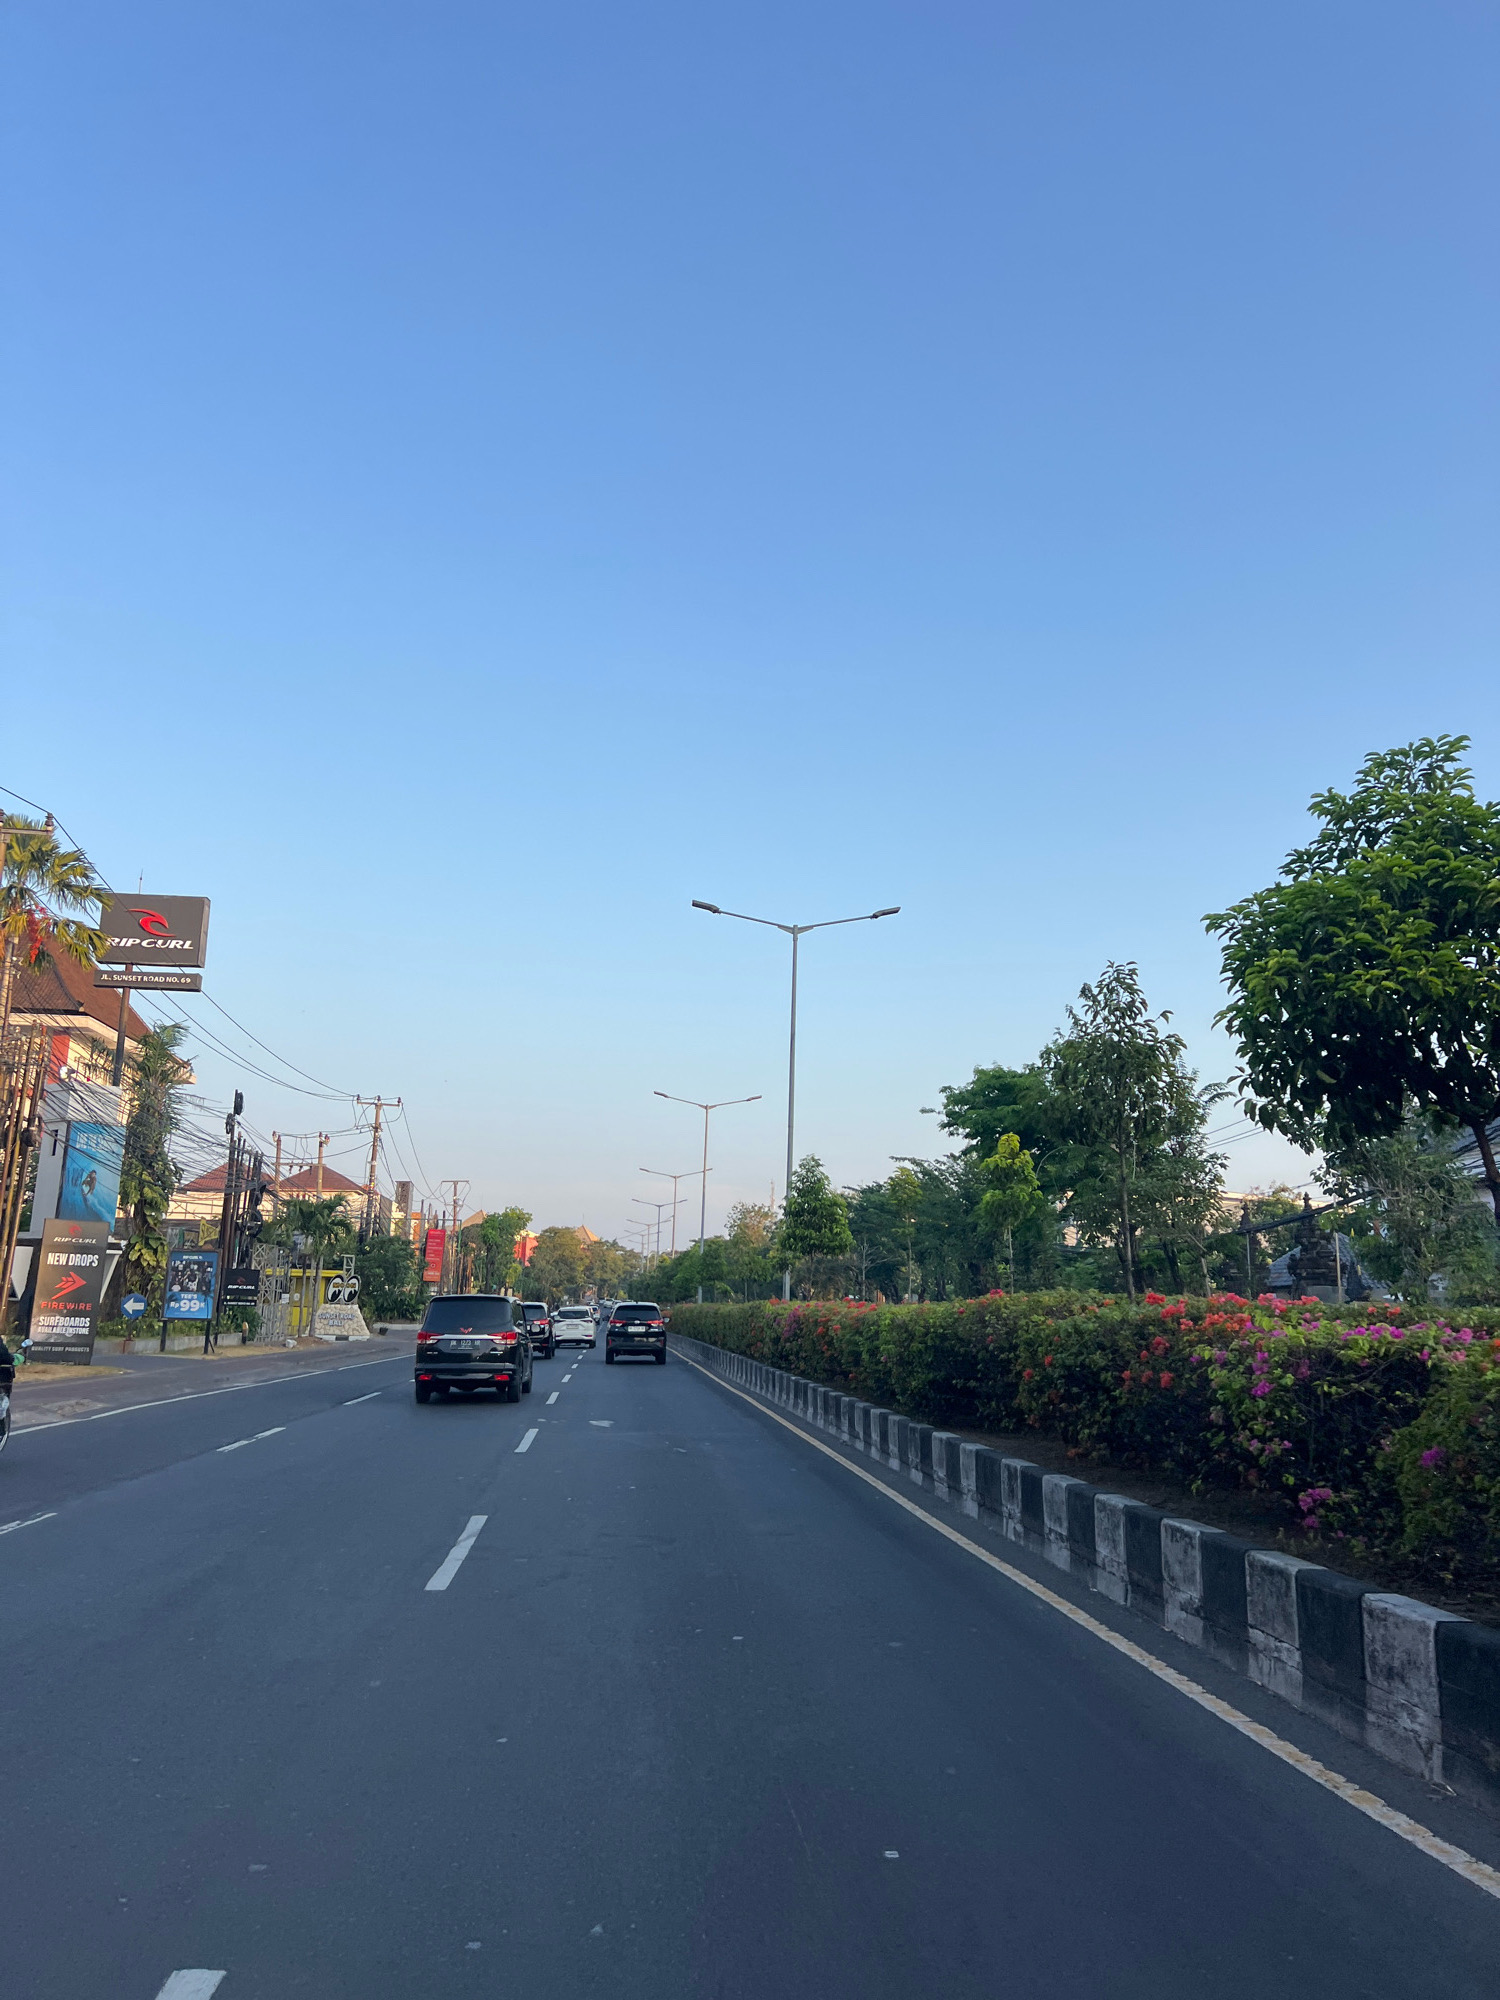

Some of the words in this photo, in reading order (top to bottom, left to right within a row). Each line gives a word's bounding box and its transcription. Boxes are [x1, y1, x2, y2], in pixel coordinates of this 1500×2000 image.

[106, 937, 141, 947] RIP
[141, 939, 194, 949] CURL
[113, 974, 142, 982] SUNSET
[47, 1252, 68, 1265] NEW
[68, 1253, 99, 1267] DROPS
[40, 1301, 92, 1310] FIREWIRE
[39, 1316, 90, 1327] SURFBOARDS
